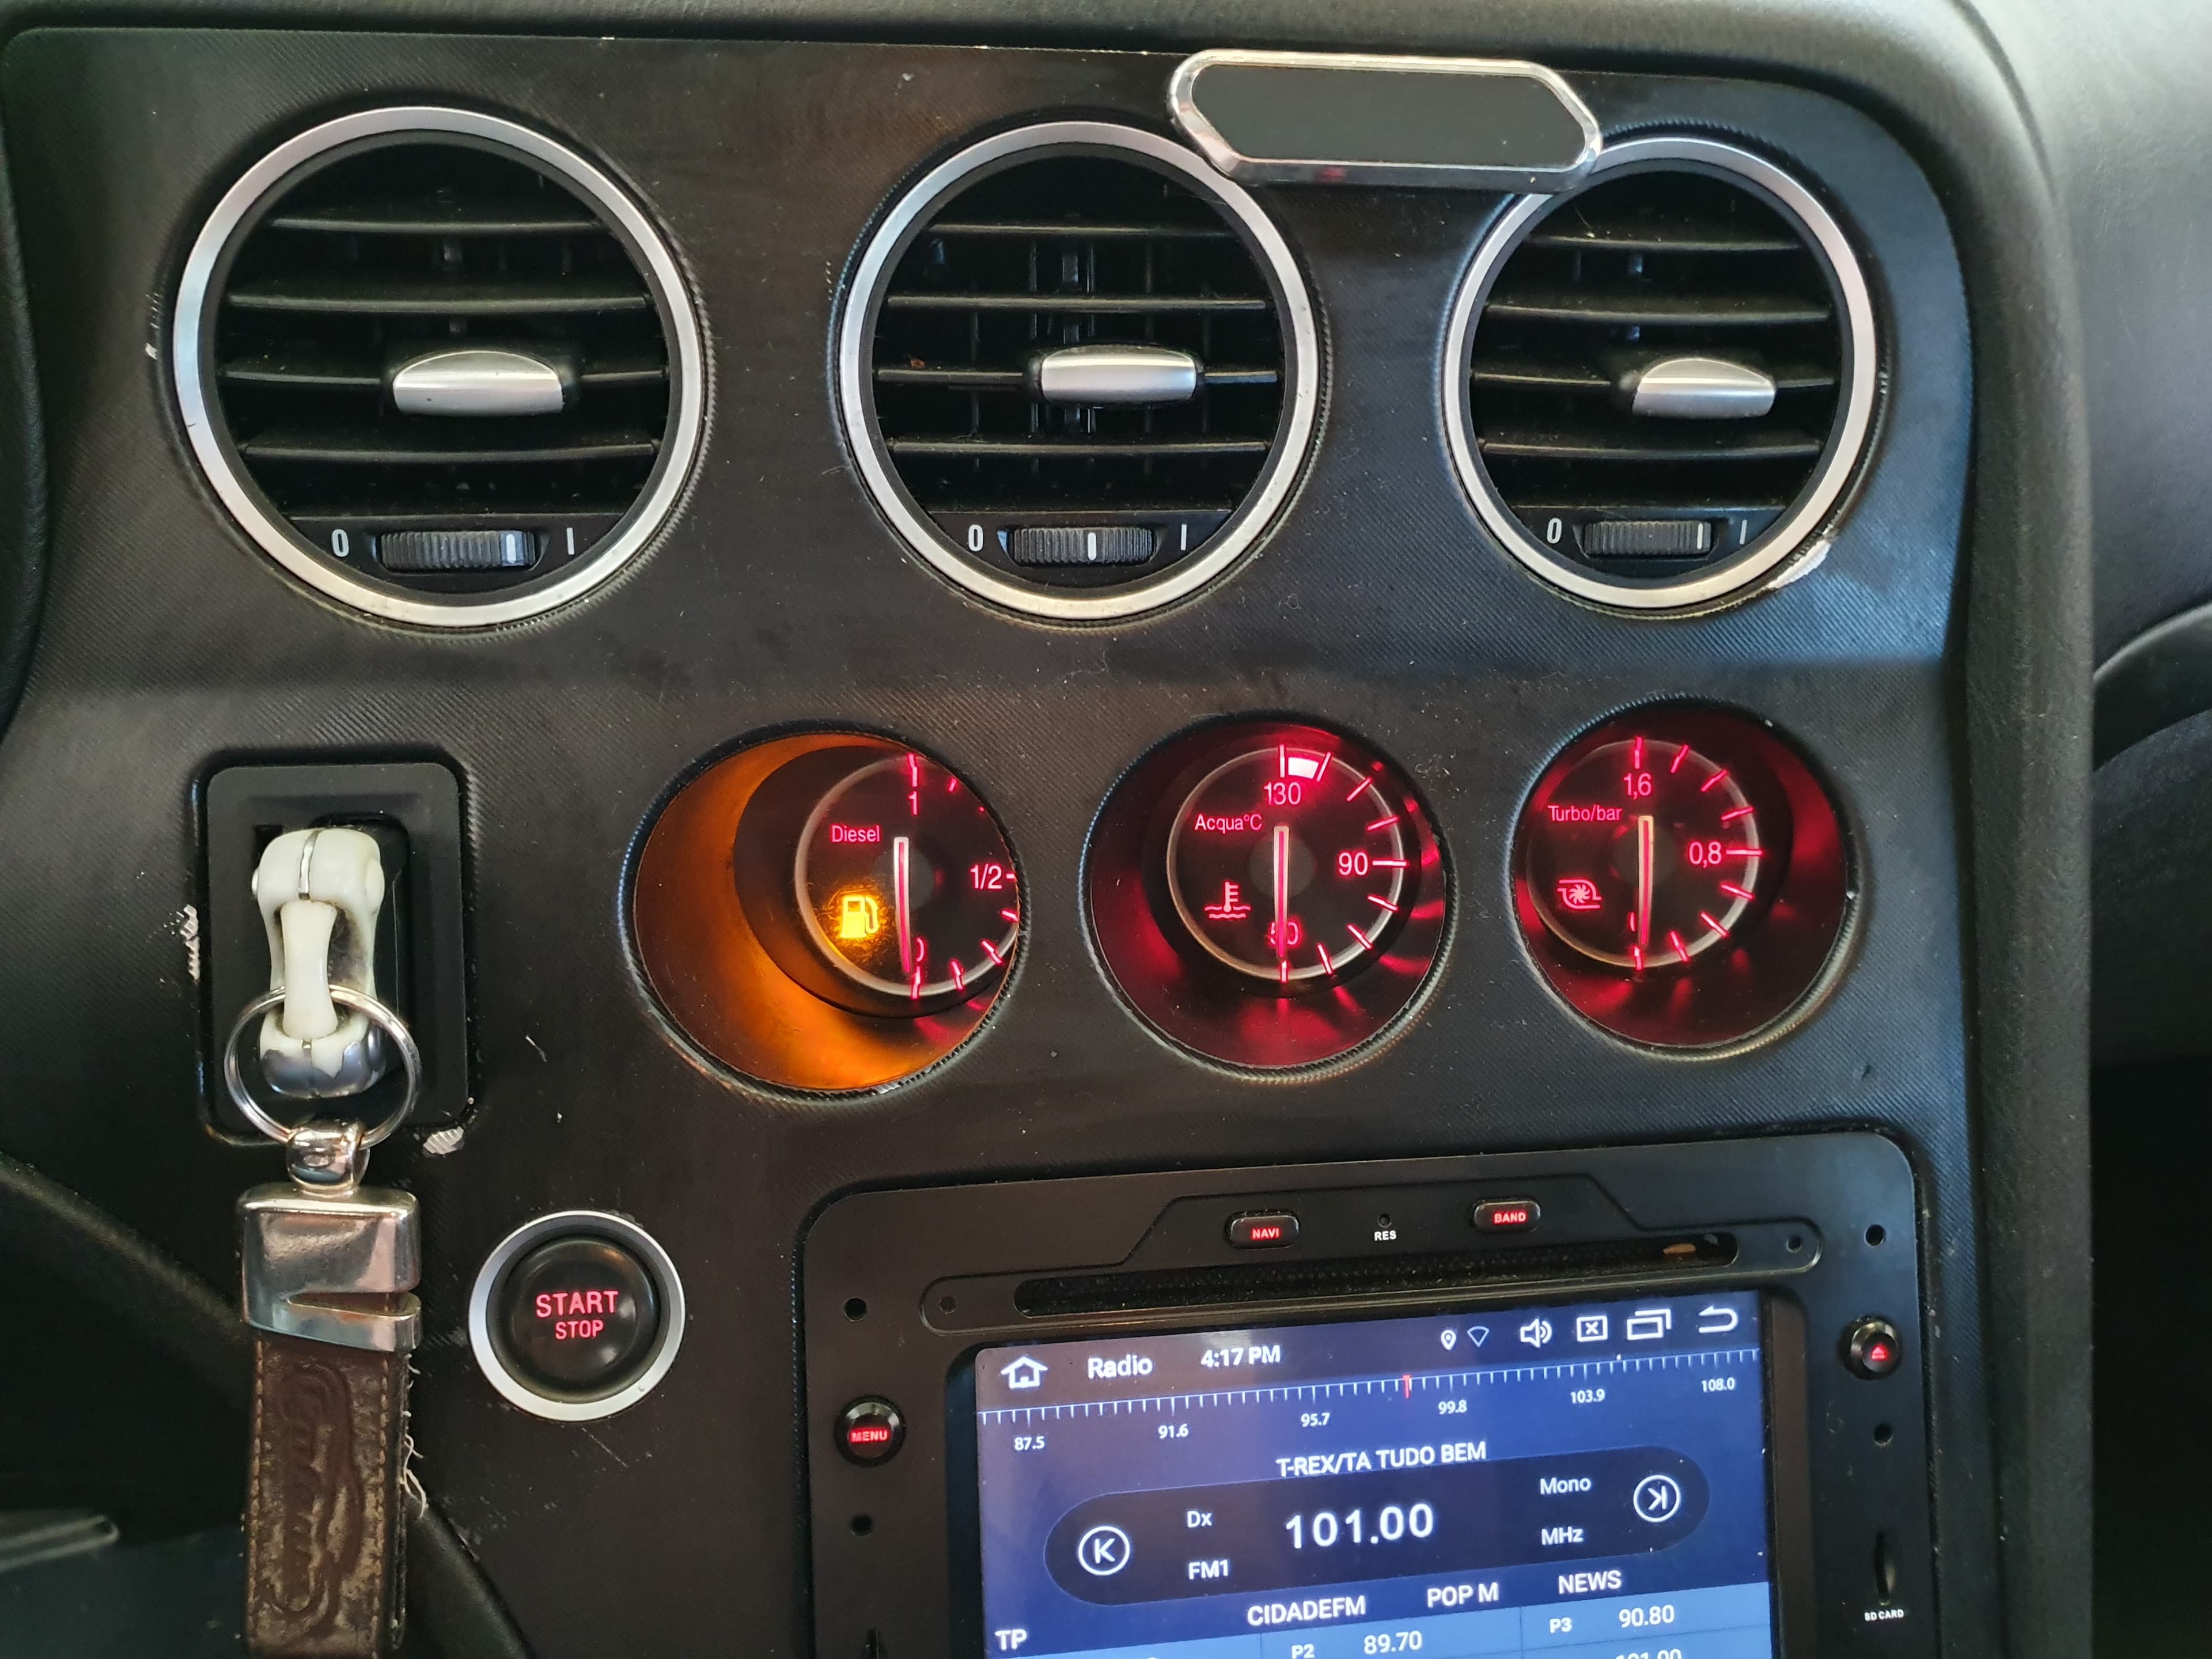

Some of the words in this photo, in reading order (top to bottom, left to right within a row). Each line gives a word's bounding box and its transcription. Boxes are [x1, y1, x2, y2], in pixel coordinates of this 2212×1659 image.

[908, 791, 917, 815] 1
[1264, 782, 1301, 805] 130
[1547, 805, 1622, 821] Turbo/bar
[832, 825, 880, 842] Diesel
[1339, 852, 1368, 876] 90
[970, 863, 1002, 889] 1/2
[1494, 1211, 1527, 1224] BAND
[1252, 1228, 1279, 1239] NAVI
[1374, 1230, 1397, 1241] RES
[536, 1290, 619, 1317] START
[555, 1320, 604, 1339] STOP
[1088, 1354, 1153, 1379] Radio
[1200, 1347, 1244, 1368] 4:17
[1248, 1344, 1281, 1365] PM
[1014, 1435, 1045, 1451] 87.5
[1158, 1423, 1189, 1439] 91.6
[1300, 1412, 1330, 1427] 95.7
[1438, 1399, 1467, 1415] 99.8
[1570, 1388, 1605, 1404] 103.9
[1701, 1377, 1736, 1392] 108.0
[851, 1430, 888, 1442] MENU
[1275, 1451, 1372, 1478] T-REX/TA
[1375, 1445, 1435, 1469] TUDO
[1441, 1441, 1486, 1463] BEM
[1540, 1477, 1592, 1495] Mono
[1187, 1510, 1213, 1528] Dx
[1286, 1503, 1434, 1549] 101.00
[1541, 1526, 1584, 1546] MHz
[1188, 1559, 1229, 1580] FM1
[1558, 1570, 1622, 1594] NEWS
[1427, 1585, 1474, 1608] POP
[1478, 1582, 1499, 1603] M
[1247, 1595, 1366, 1626] CIDADEFM
[1550, 1617, 1572, 1634] P3
[1619, 1604, 1675, 1628] 90.80
[1864, 1611, 1877, 1621] SD
[1878, 1609, 1904, 1620] CARD
[994, 1628, 1028, 1650] TP
[1291, 1643, 1315, 1659] P2
[1364, 1630, 1422, 1655] 89.70
